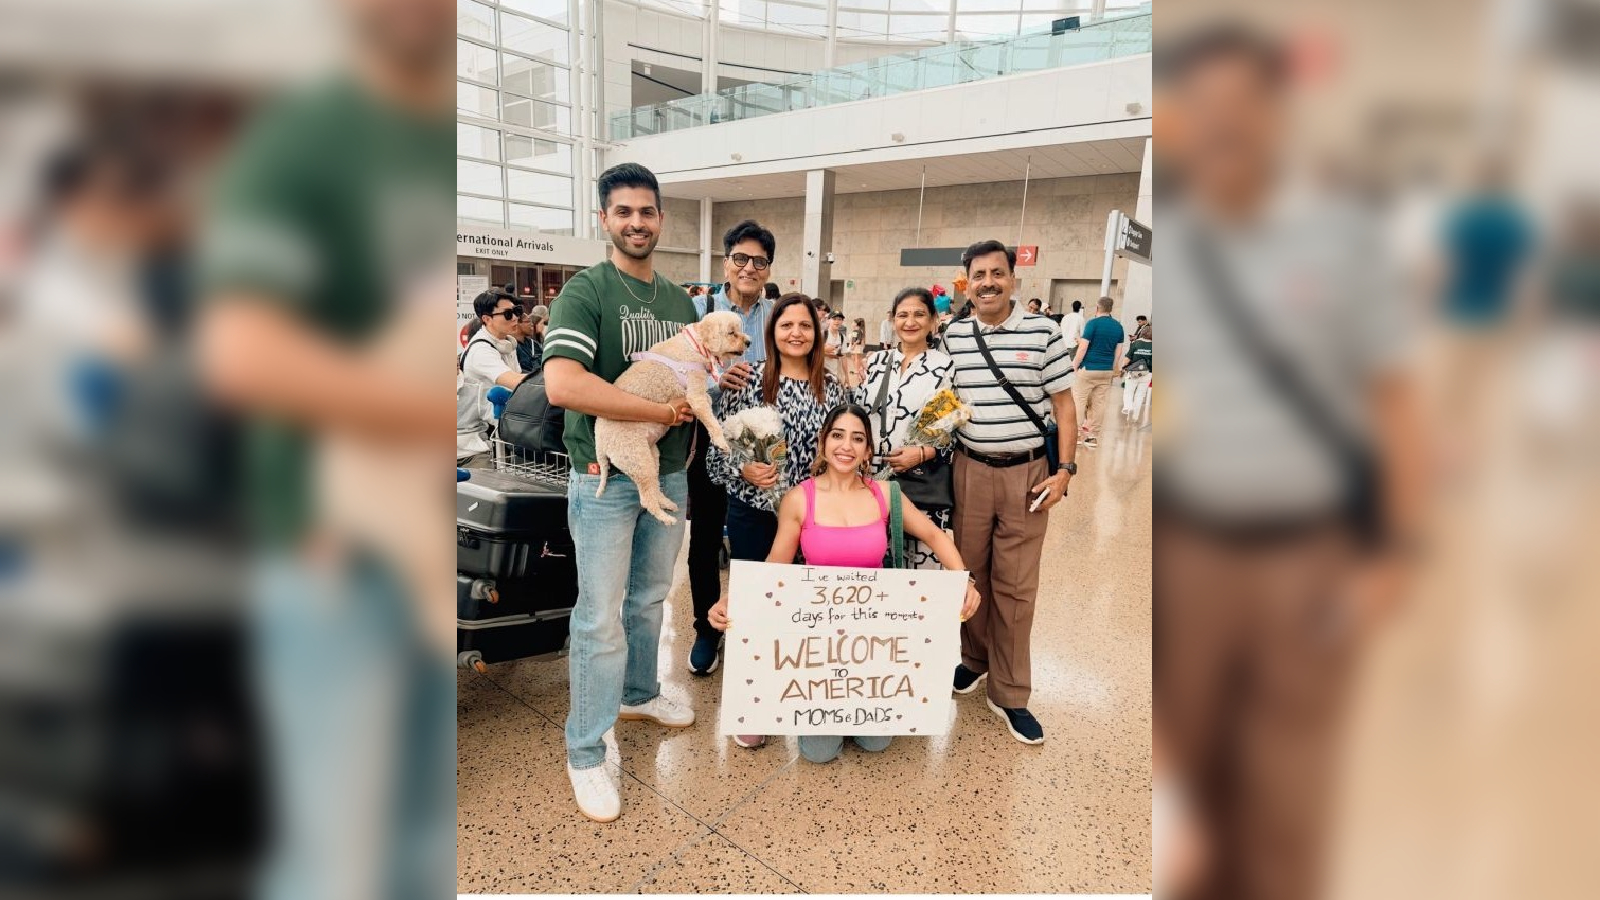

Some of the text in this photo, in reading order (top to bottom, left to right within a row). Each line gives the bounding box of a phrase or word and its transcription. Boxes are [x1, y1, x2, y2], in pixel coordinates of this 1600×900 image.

[516, 239, 554, 252] Arrivals
[619, 304, 656, 320] Quality
[836, 570, 878, 582] waited
[791, 607, 823, 629] days
[828, 607, 846, 624] for
[851, 607, 879, 620] this
[774, 634, 910, 671] WELCOME
[831, 668, 849, 678] TO
[780, 674, 915, 703] AMERICA
